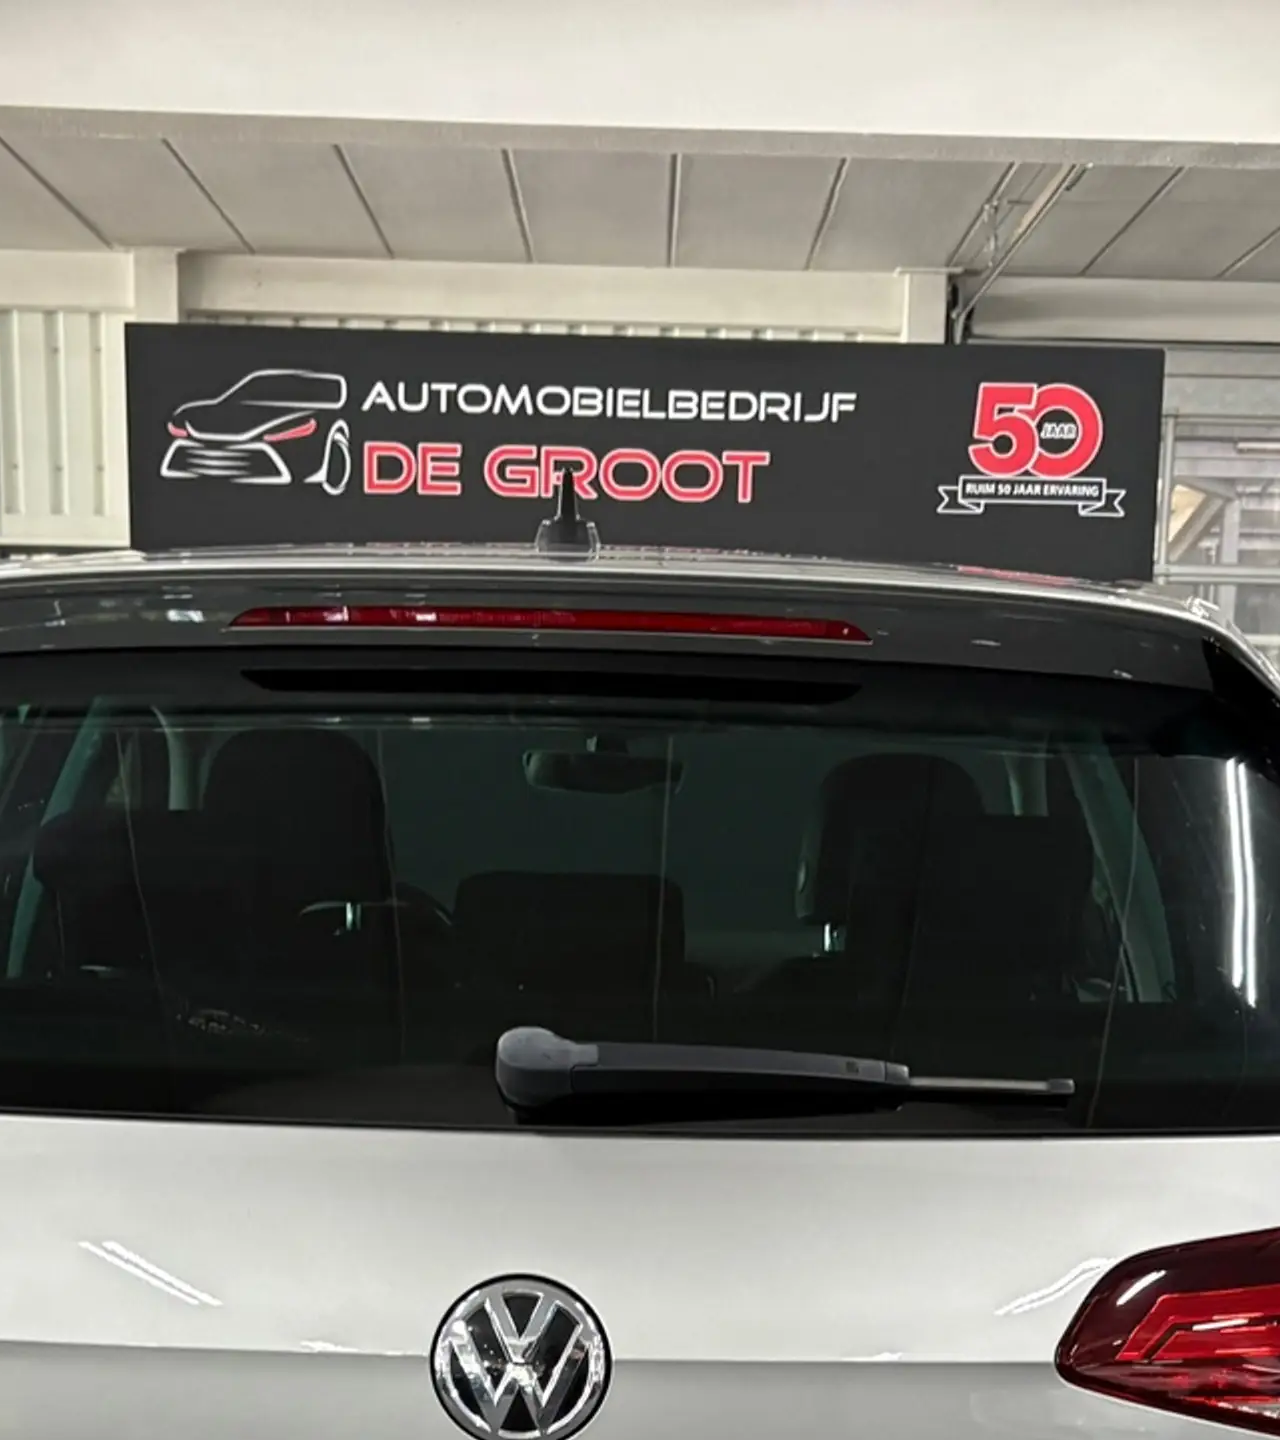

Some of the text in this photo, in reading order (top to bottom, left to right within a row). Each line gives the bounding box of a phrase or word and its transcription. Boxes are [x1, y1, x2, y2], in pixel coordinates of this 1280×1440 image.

[361, 380, 858, 423] AUTOMOBIELBEDRIJF
[967, 382, 1104, 481] 50
[1040, 421, 1078, 440] JAAR
[363, 440, 770, 504] DE GROOT
[965, 483, 1099, 498] RUIM 50 JAAR ERVARING
